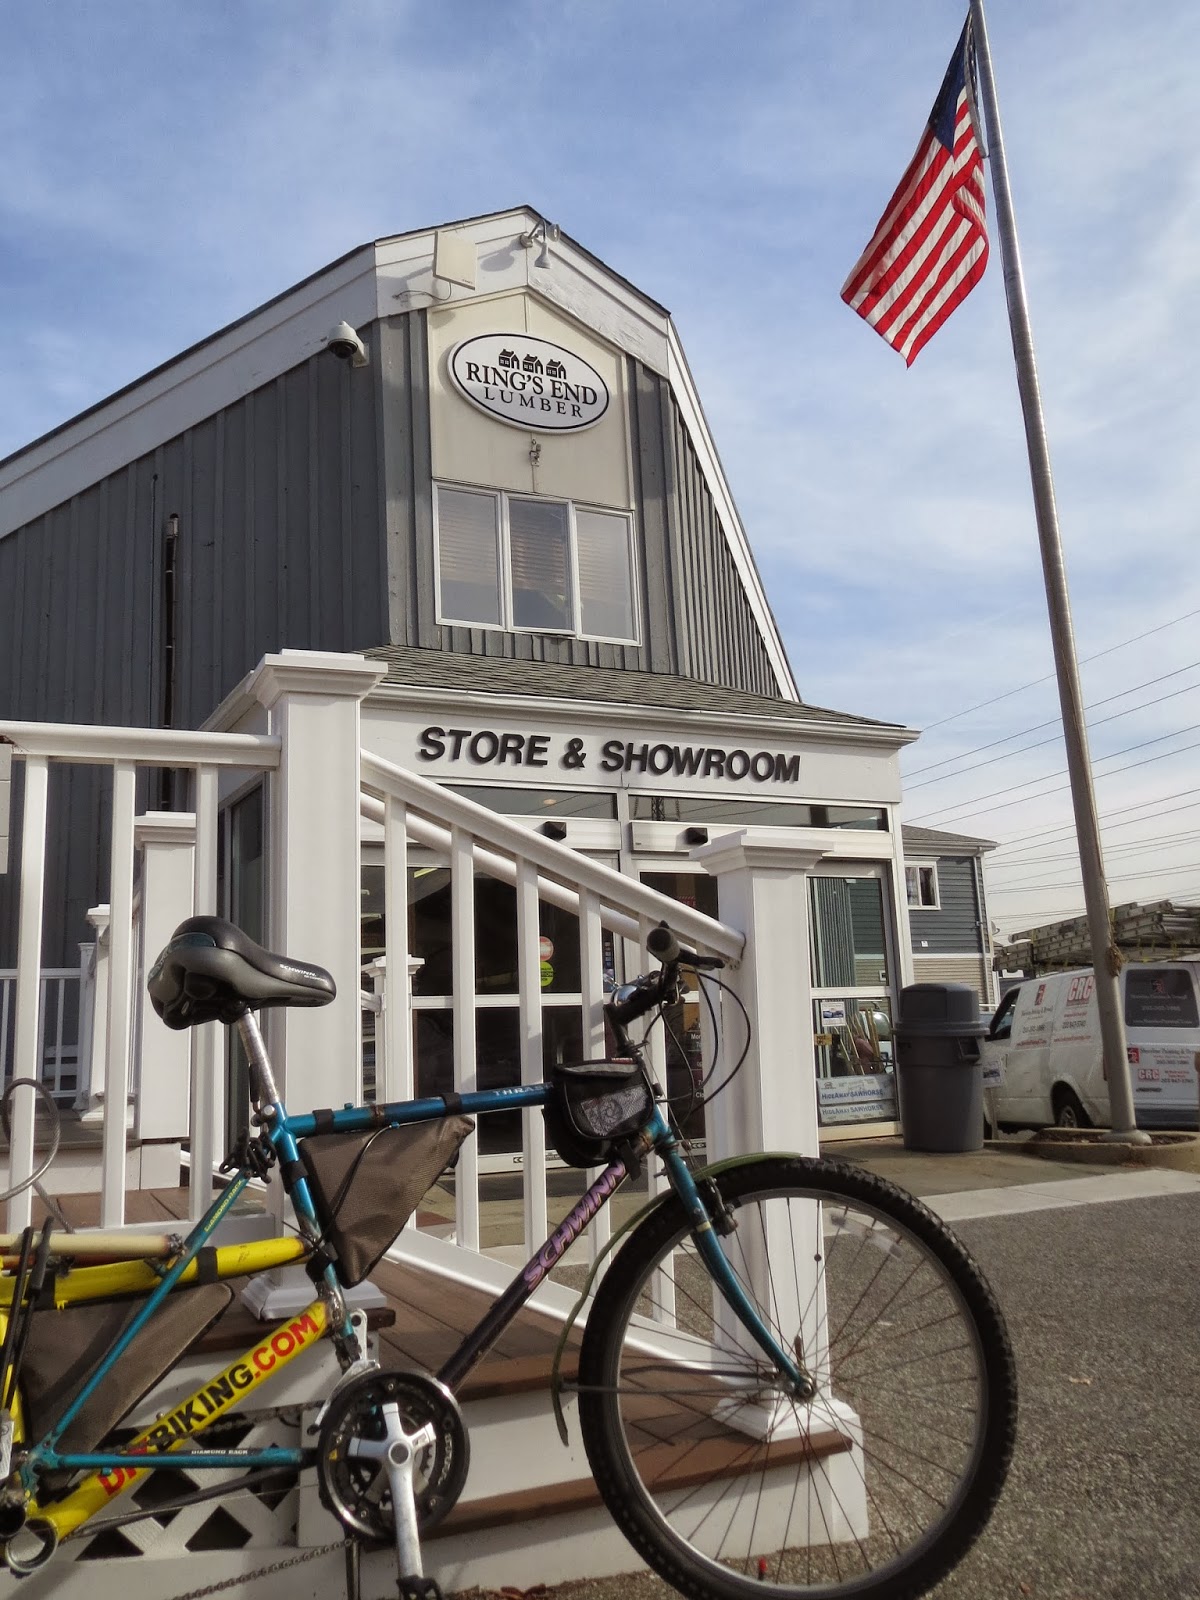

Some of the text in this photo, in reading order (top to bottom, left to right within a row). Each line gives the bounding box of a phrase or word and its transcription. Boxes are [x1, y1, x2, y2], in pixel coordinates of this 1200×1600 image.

[465, 361, 598, 406] RING'S END
[484, 386, 583, 418] LUMBER
[420, 726, 801, 782] STORE & SHOWROOM
[1067, 975, 1095, 1001] CRC
[523, 1159, 627, 1291] SCHWINN
